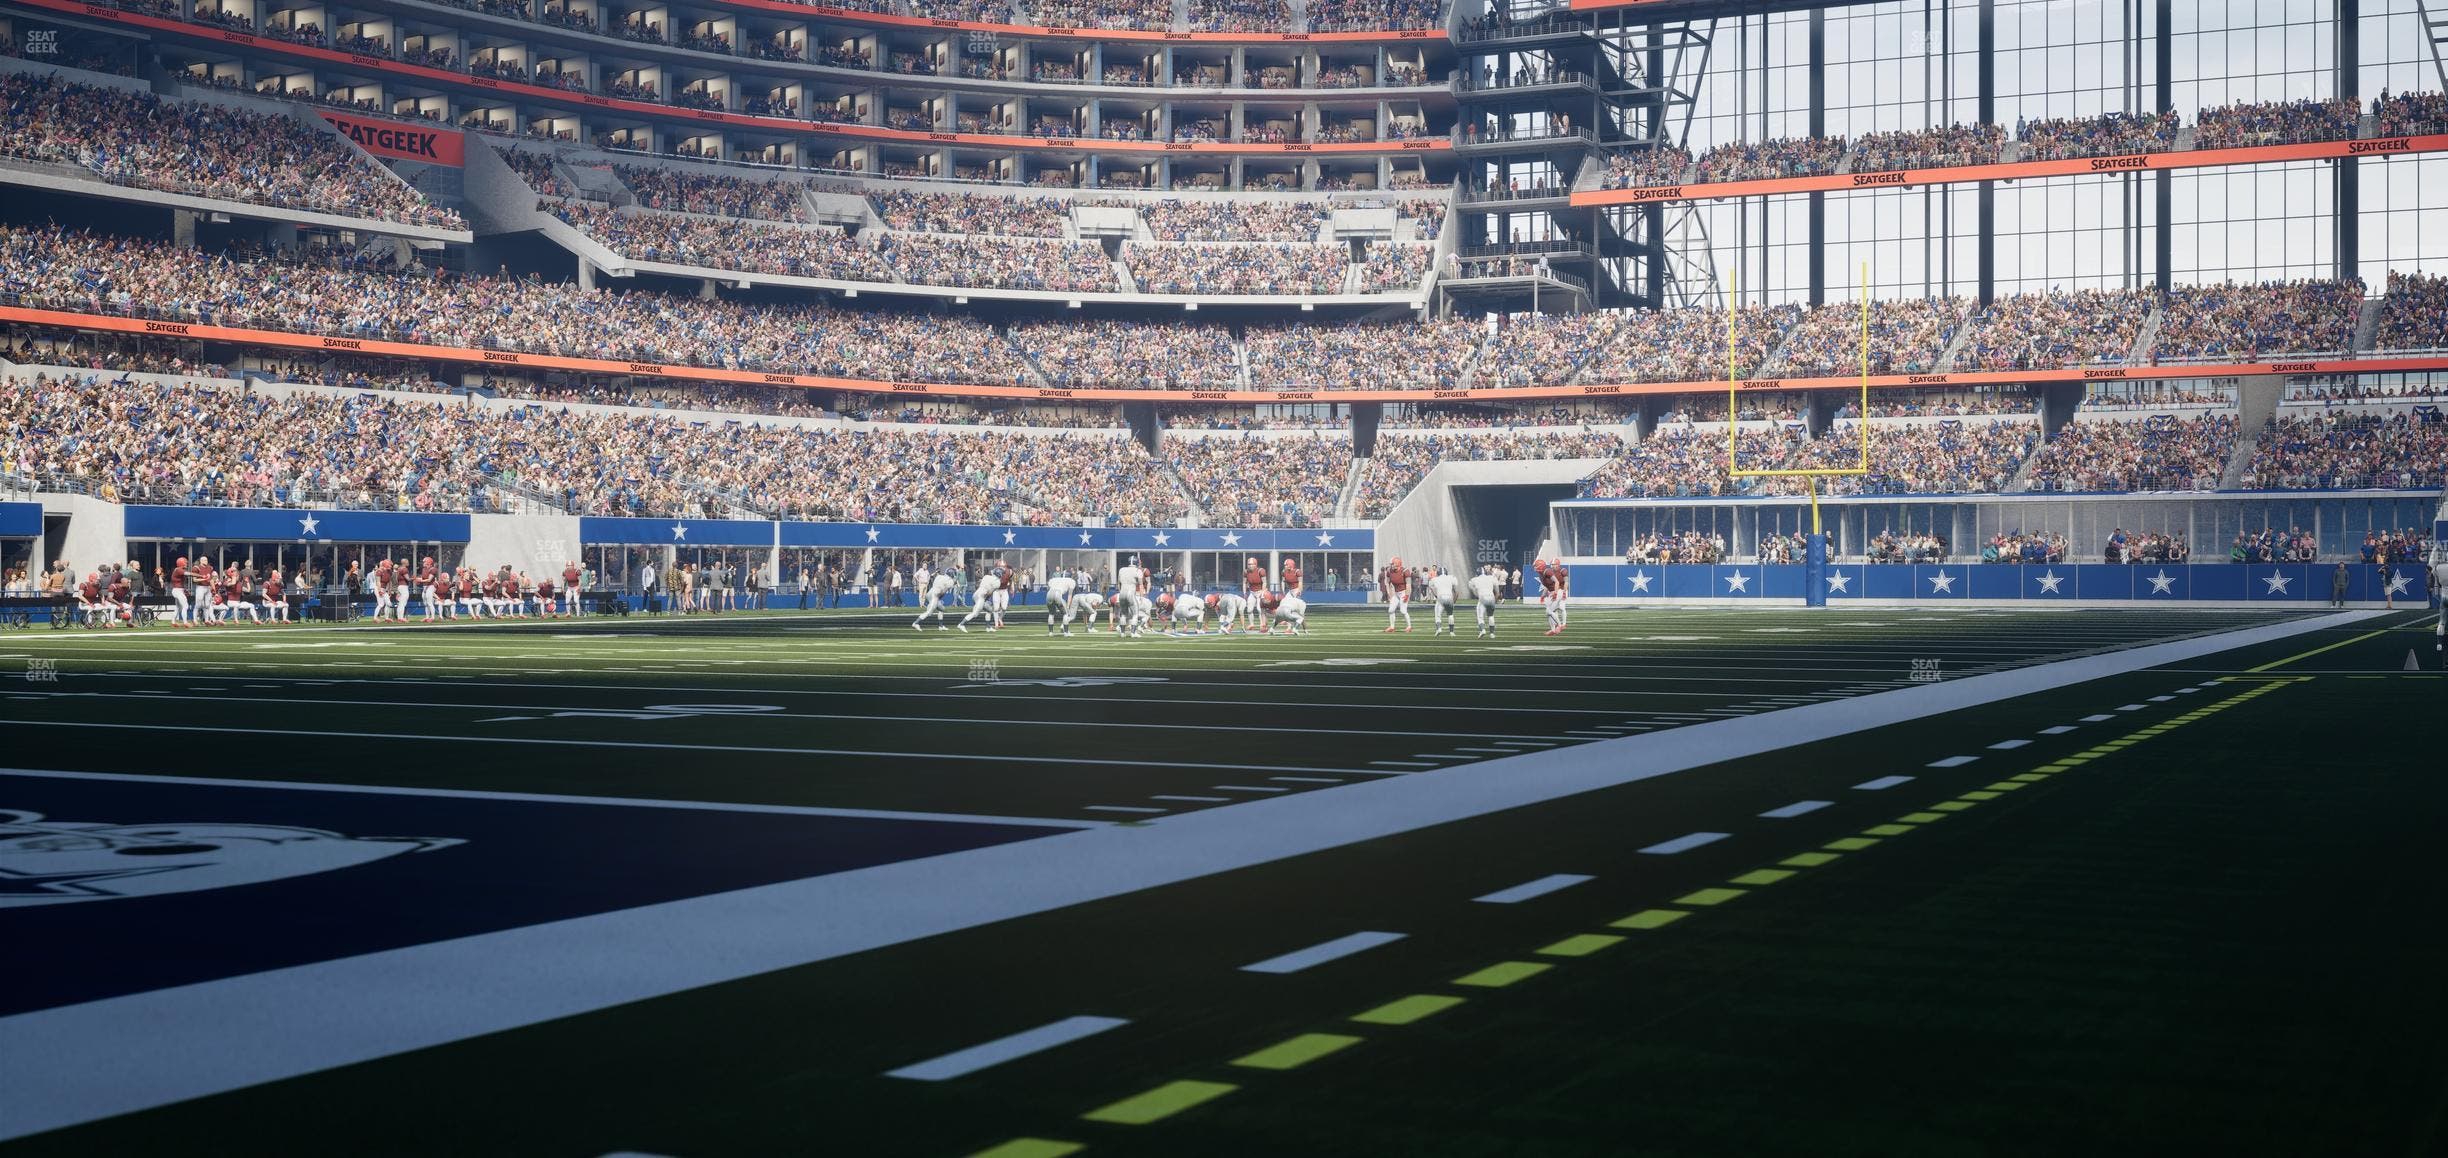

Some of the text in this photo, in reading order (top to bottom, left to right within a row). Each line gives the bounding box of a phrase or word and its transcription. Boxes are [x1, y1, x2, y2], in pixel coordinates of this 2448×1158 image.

[87, 7, 118, 18] SEATGEEK
[817, 7, 844, 16] SEATGEEK
[932, 19, 959, 27] SEATGEEK
[224, 32, 254, 43] SEATGEEK
[352, 56, 381, 67] SEATGEEK
[471, 77, 498, 87] SEATGEEK
[813, 124, 840, 132] SEATGEEK
[325, 117, 438, 159] EATGEEK
[2348, 139, 2411, 153] SEATGEEK
[2091, 156, 2148, 170] SEATGEEK
[1853, 172, 1906, 186] SEATGEEK
[1633, 187, 1682, 200] SEATGEEK
[146, 322, 189, 334] SEATGEEK
[324, 338, 361, 350] SEATGEEK
[484, 352, 519, 363] SEATGEEK
[631, 364, 663, 374] SEATGEEK
[2085, 368, 2126, 378] SEATGEEK
[2272, 363, 2317, 373] SEATGEEK
[765, 375, 795, 383] SEATGEEK
[1909, 375, 1948, 384] SEATGEEK
[893, 384, 928, 392] SEATGEEK
[1585, 385, 1620, 394] SEATGEEK
[1743, 380, 1780, 389] SEATGEEK
[1039, 390, 1073, 398] SEATGEEK
